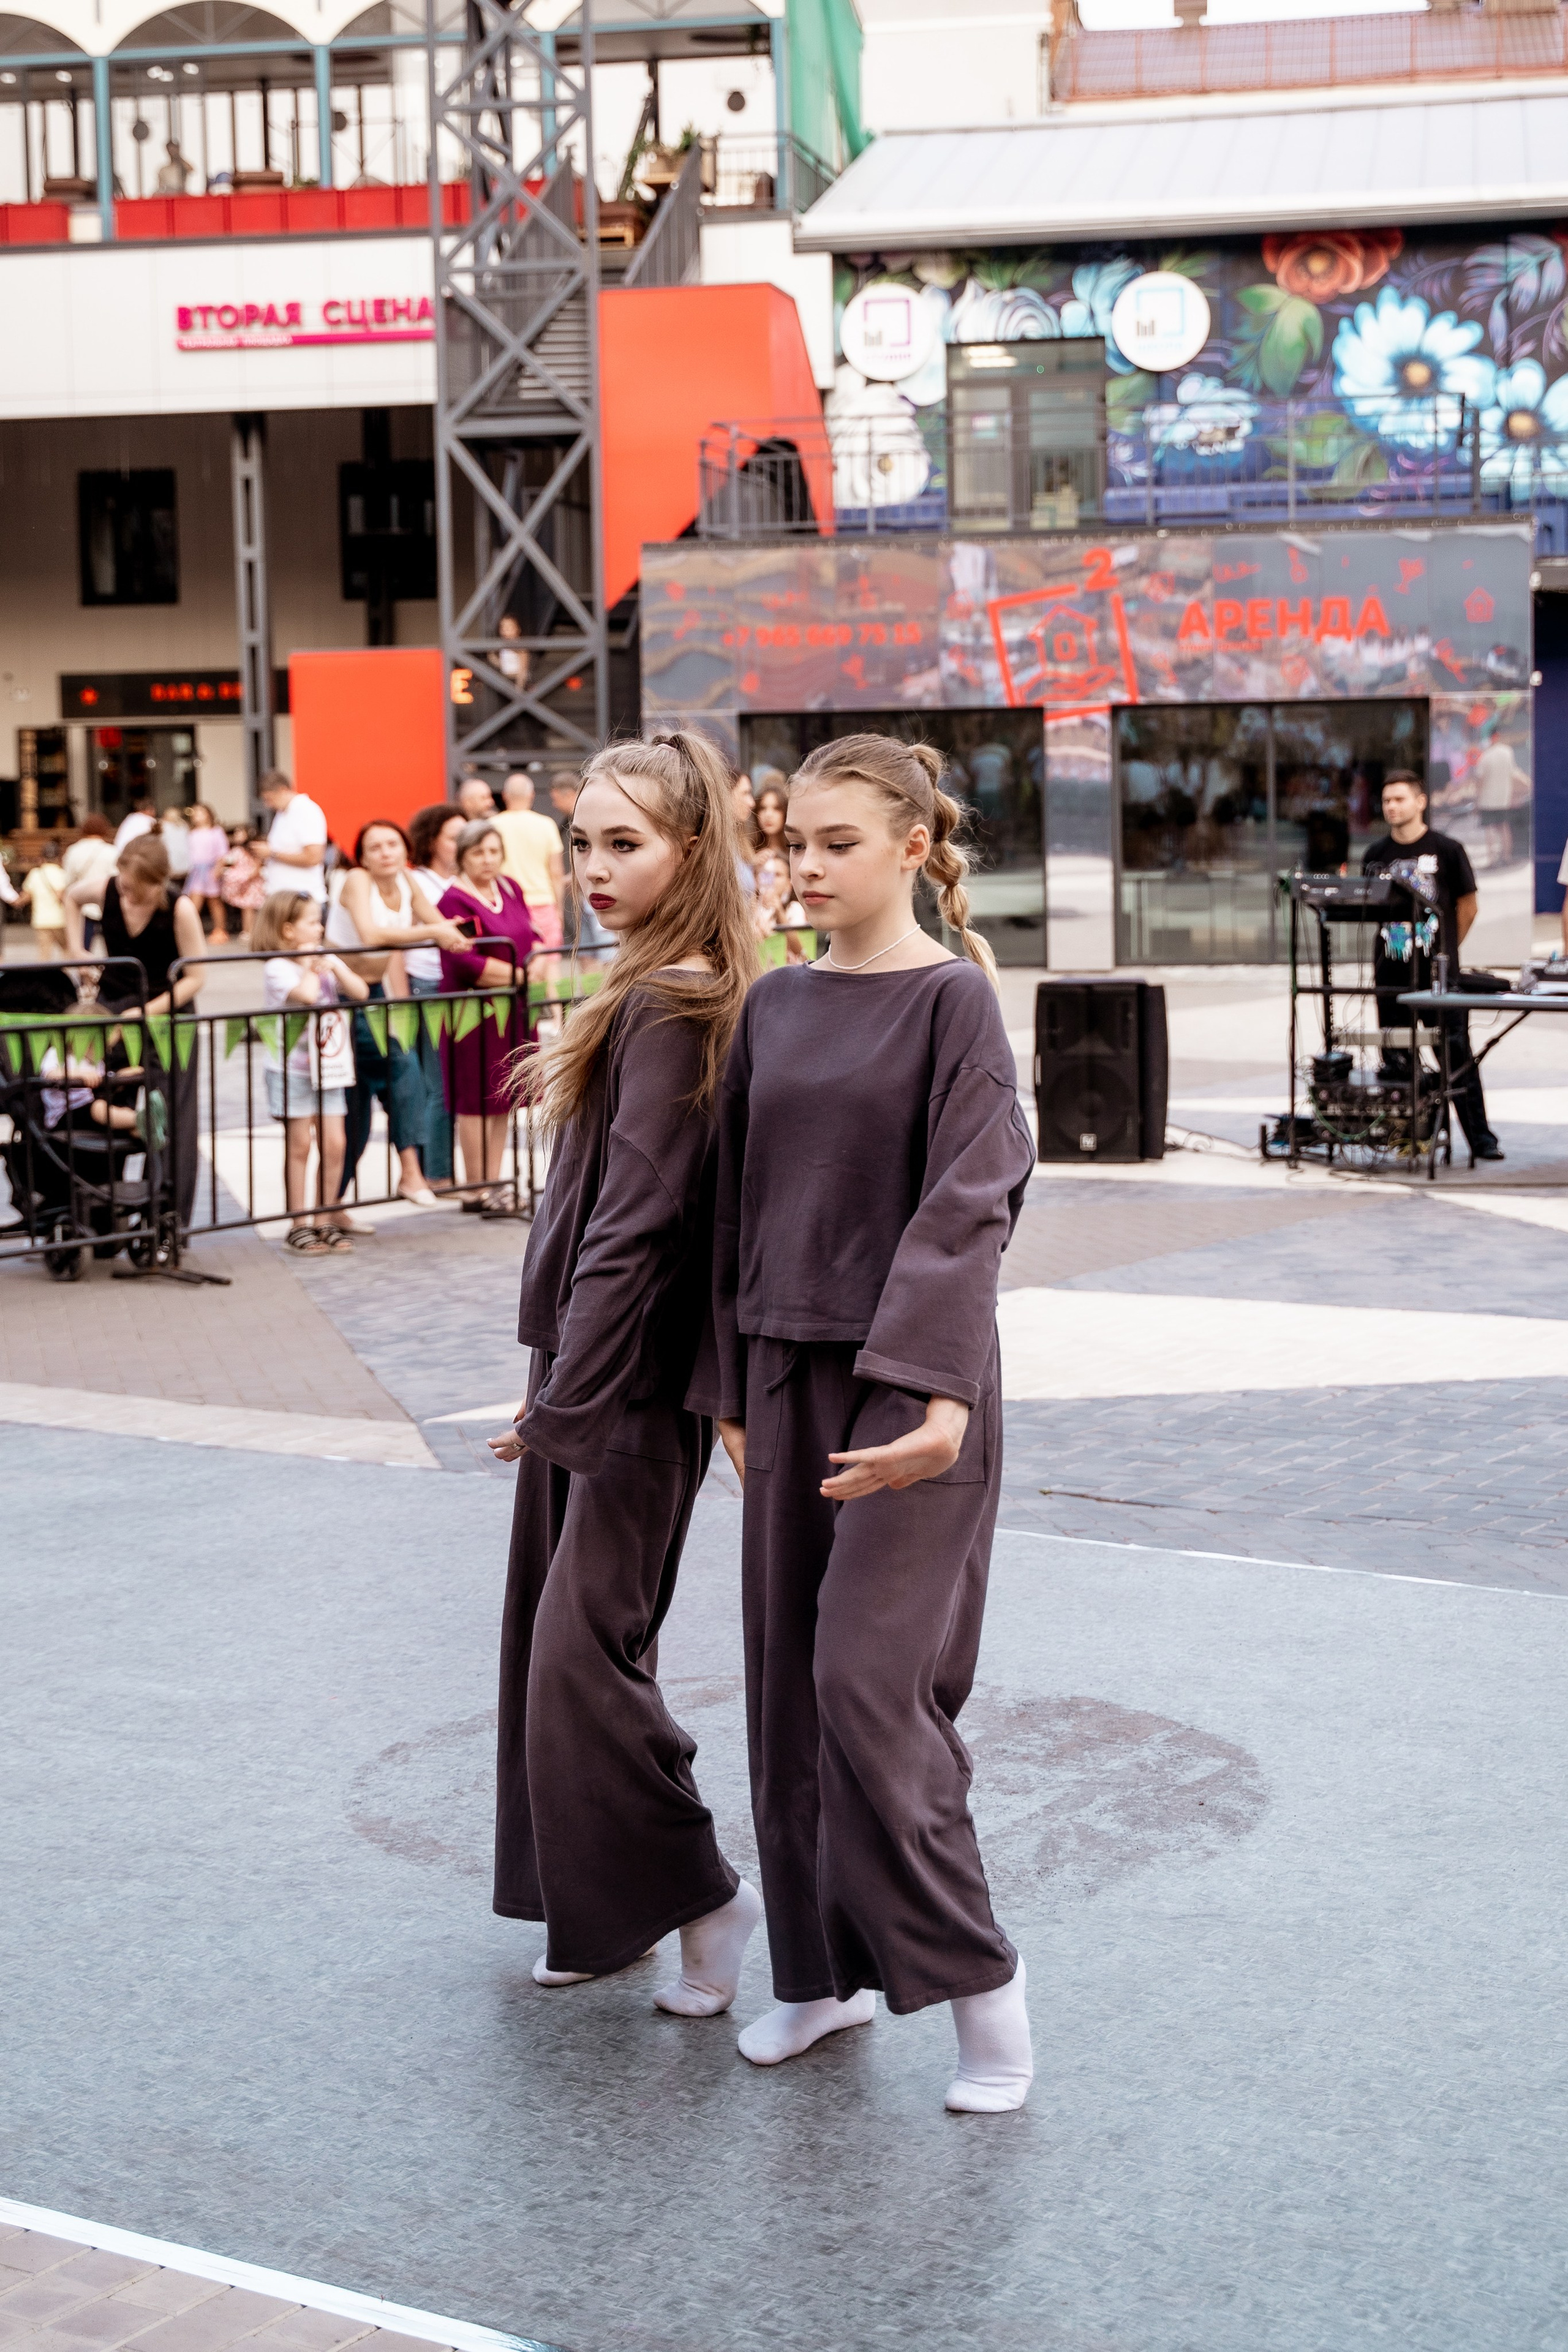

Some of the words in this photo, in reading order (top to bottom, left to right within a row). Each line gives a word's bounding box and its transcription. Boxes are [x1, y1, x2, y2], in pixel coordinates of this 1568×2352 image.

[177, 303, 301, 331] ВТОРАЯ
[323, 298, 434, 330] СЦЕНА
[1177, 597, 1390, 644] АРЕНДА
